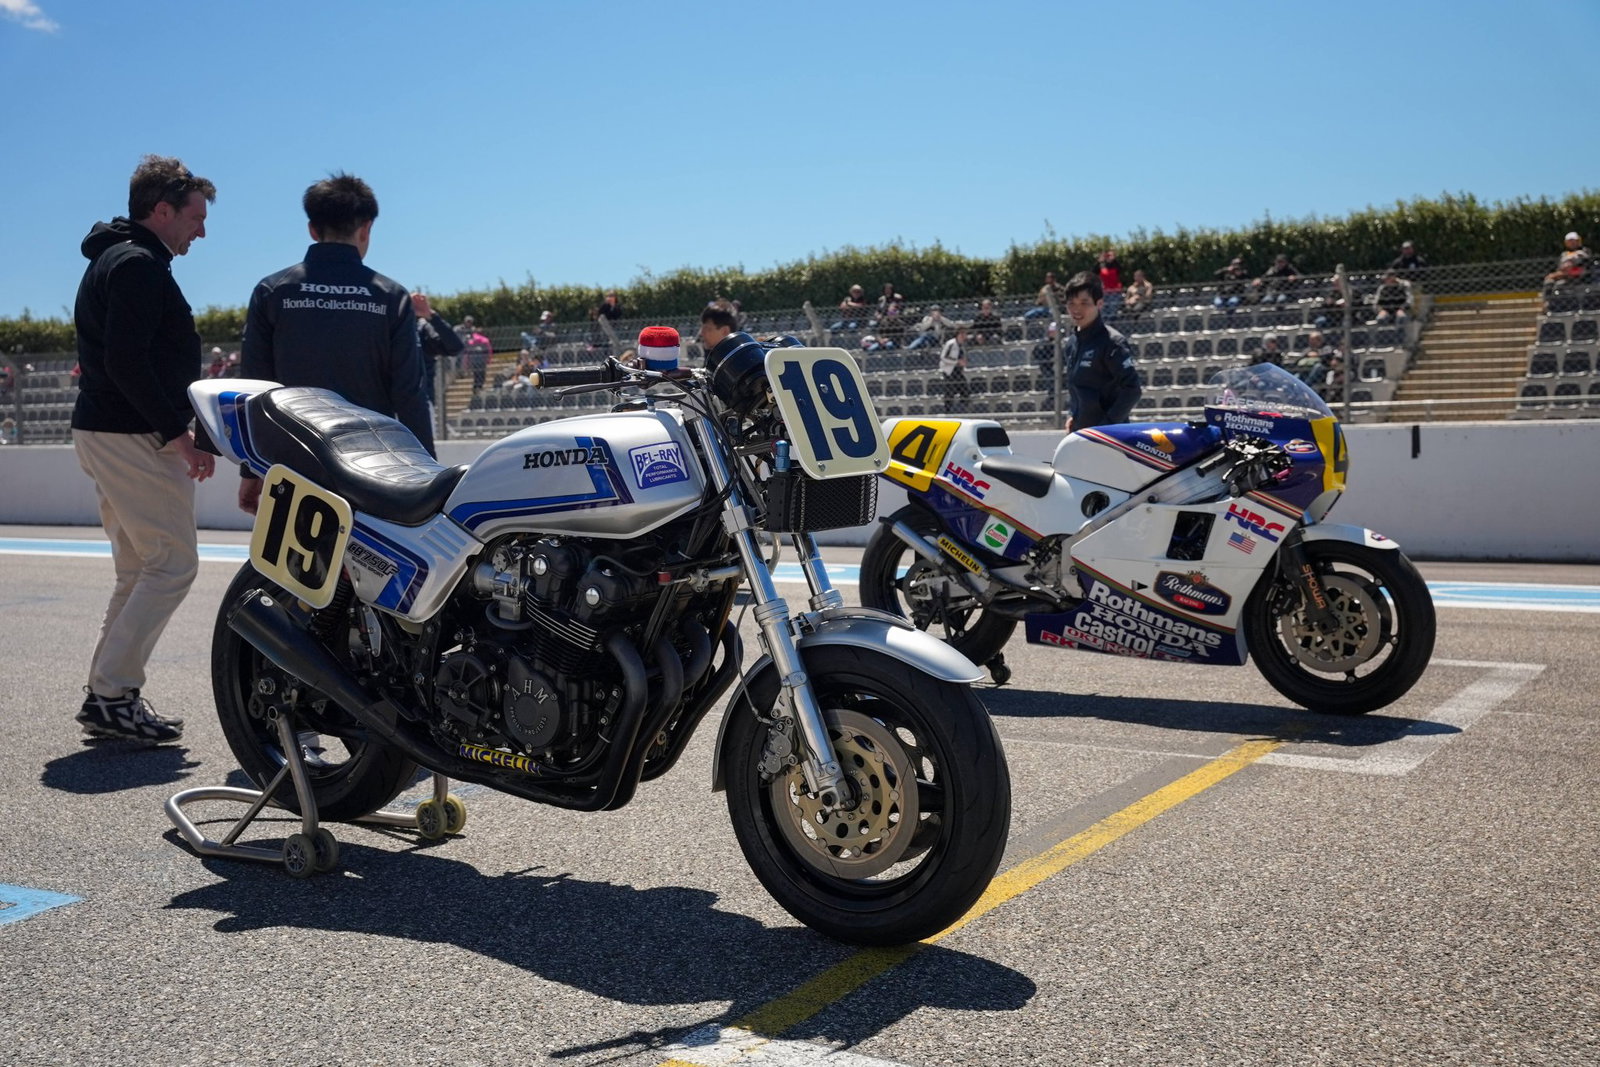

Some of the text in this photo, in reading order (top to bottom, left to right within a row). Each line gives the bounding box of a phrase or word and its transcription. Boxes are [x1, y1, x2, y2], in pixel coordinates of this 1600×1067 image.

[301, 282, 372, 296] HONDA
[282, 299, 387, 316] Honda Collection Hall
[778, 358, 878, 462] 19
[1223, 412, 1275, 429] Rothmans
[1225, 422, 1271, 435] HONDA
[522, 447, 609, 470] HONDA
[634, 447, 682, 475] BEL-RAY
[892, 424, 938, 479] 4
[1136, 440, 1173, 462] HONDA
[942, 461, 991, 500] HRC
[261, 477, 340, 590] 19
[1223, 503, 1286, 543] HRC
[346, 541, 401, 576] CB750F
[939, 537, 981, 573] MICHELIN
[1162, 574, 1225, 607] Rothmans
[1301, 564, 1327, 609] SHOWA
[1088, 580, 1223, 647] Rothmans
[1090, 603, 1210, 657] HONDA
[1042, 631, 1076, 649] RK
[1067, 628, 1099, 645] OKI
[1074, 611, 1155, 655] Castrol
[511, 679, 549, 705] AHM
[460, 744, 541, 775] MICHELIN
